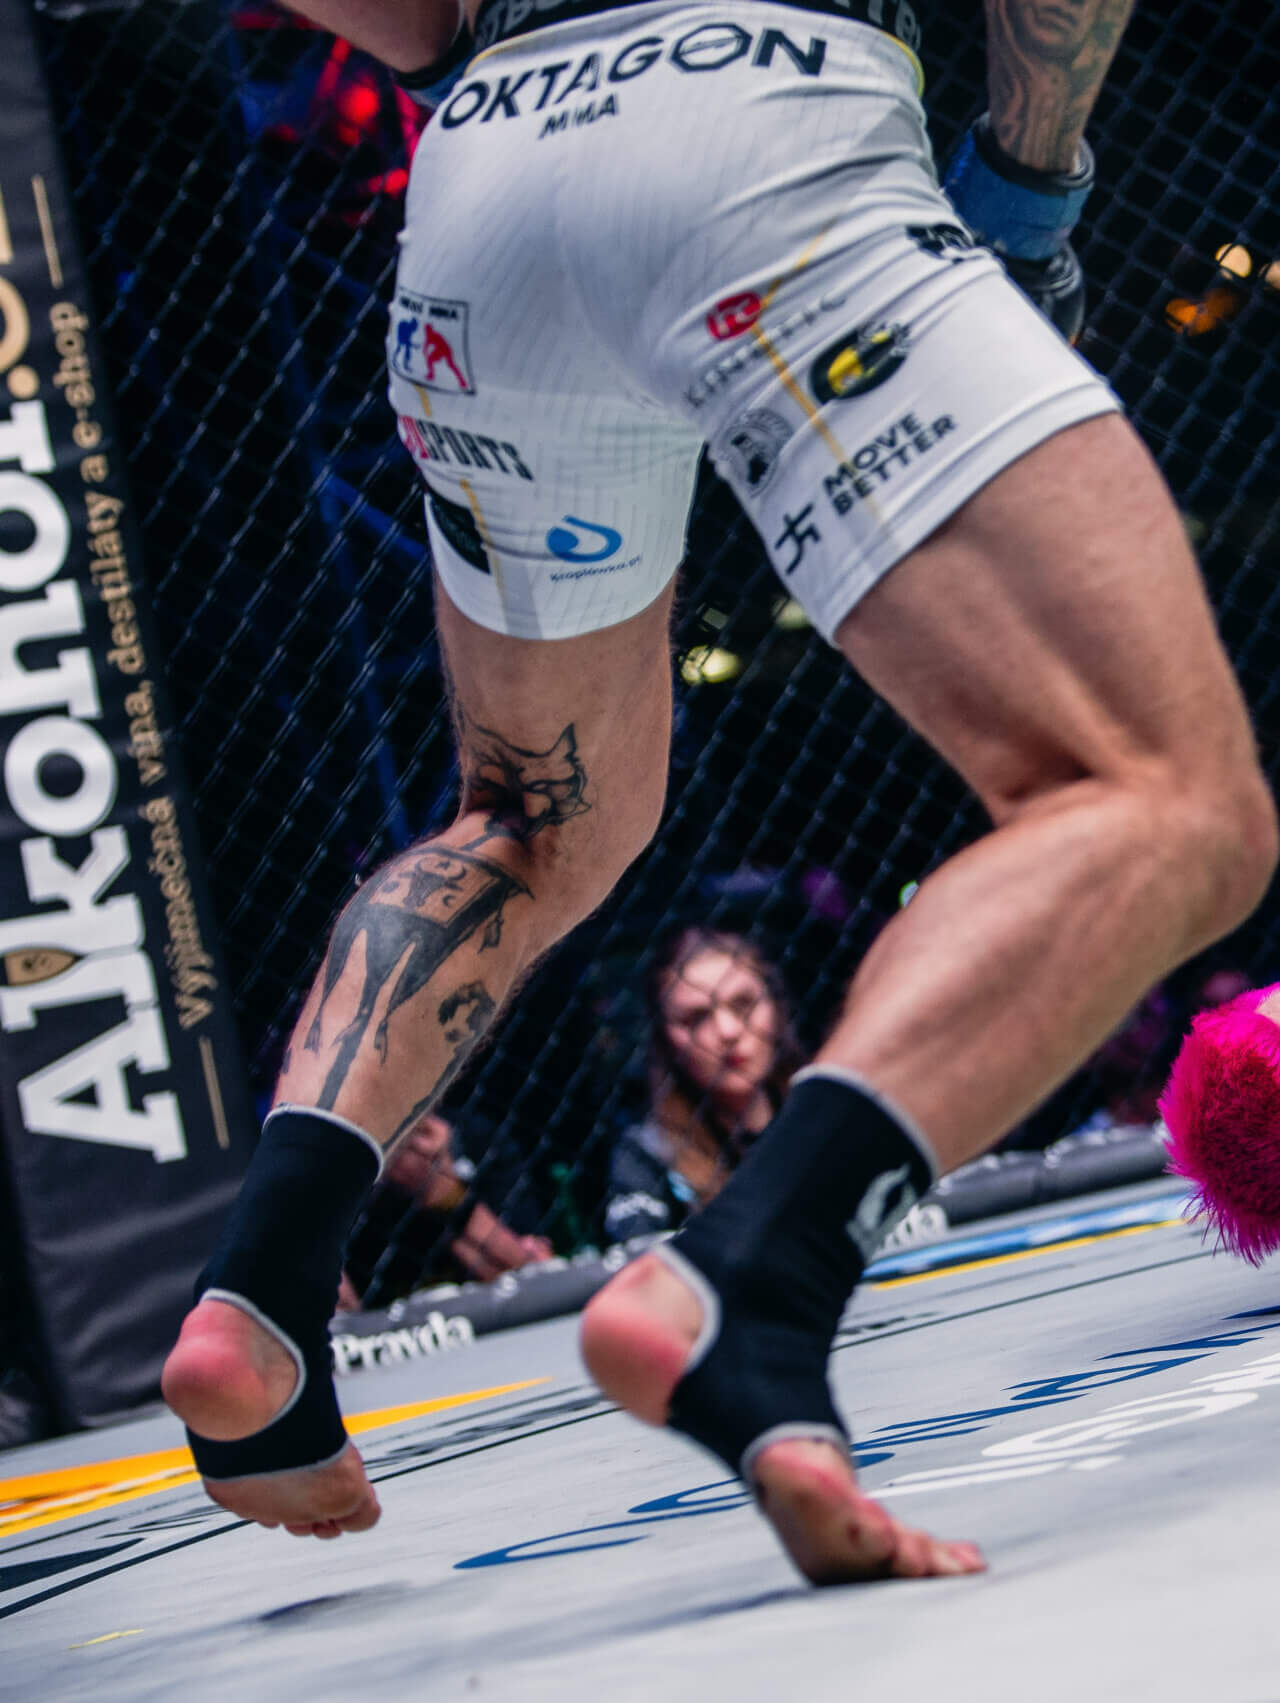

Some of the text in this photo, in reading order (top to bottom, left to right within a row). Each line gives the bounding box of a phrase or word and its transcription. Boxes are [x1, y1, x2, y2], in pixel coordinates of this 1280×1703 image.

[441, 22, 827, 129] OKTAGON
[49, 301, 104, 449] e-shop
[80, 453, 109, 484] a
[823, 411, 922, 497] MOVE
[830, 413, 956, 517] BETTER
[0, 175, 188, 1163] Alkoho.
[331, 1310, 476, 1375] Pravda
